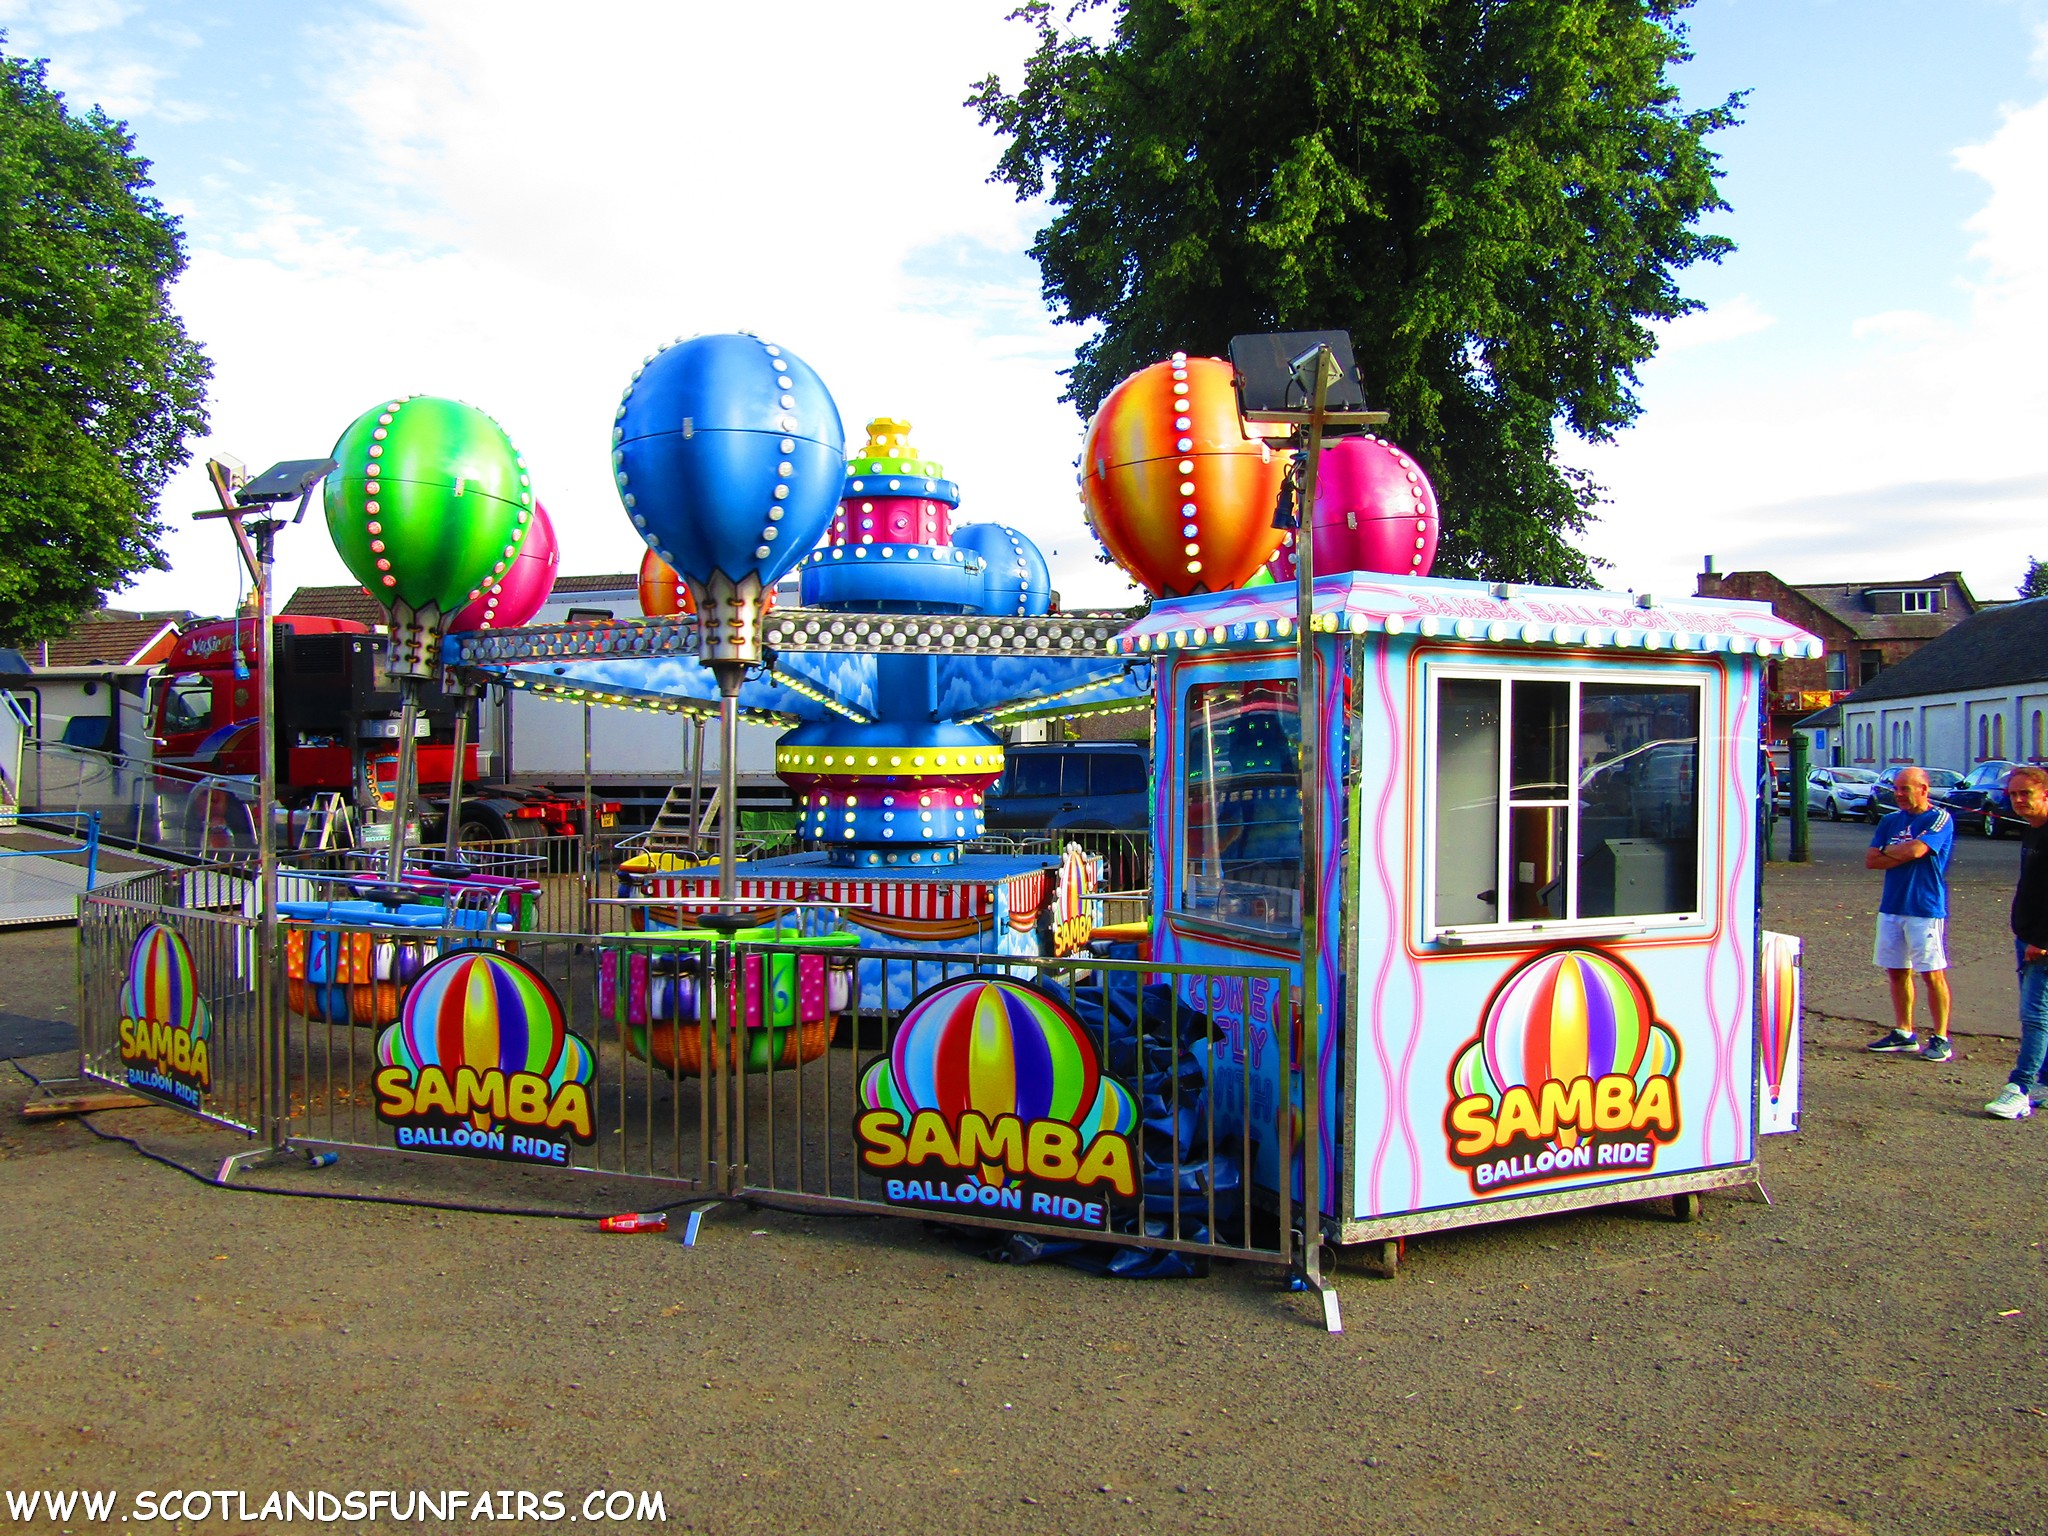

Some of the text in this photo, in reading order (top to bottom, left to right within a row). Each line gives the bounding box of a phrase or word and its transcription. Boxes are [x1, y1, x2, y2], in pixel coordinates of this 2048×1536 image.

[1408, 593, 1746, 635] SAMBA BALLOON RIDE
[1054, 915, 1092, 957] SAMBA
[1189, 975, 1269, 1022] COME
[119, 1018, 209, 1086] SAMBA
[1216, 1015, 1267, 1069] FLY
[128, 1068, 199, 1106] BALLOON RIDE
[376, 1066, 592, 1137] SAMBA
[1452, 1076, 1673, 1154] SAMBA
[399, 1127, 567, 1162] BALLOON RIDE
[859, 1111, 1135, 1195] SAMBA
[1476, 1143, 1650, 1186] BALLOON RIDE
[886, 1179, 1103, 1225] BALLOON RIDE
